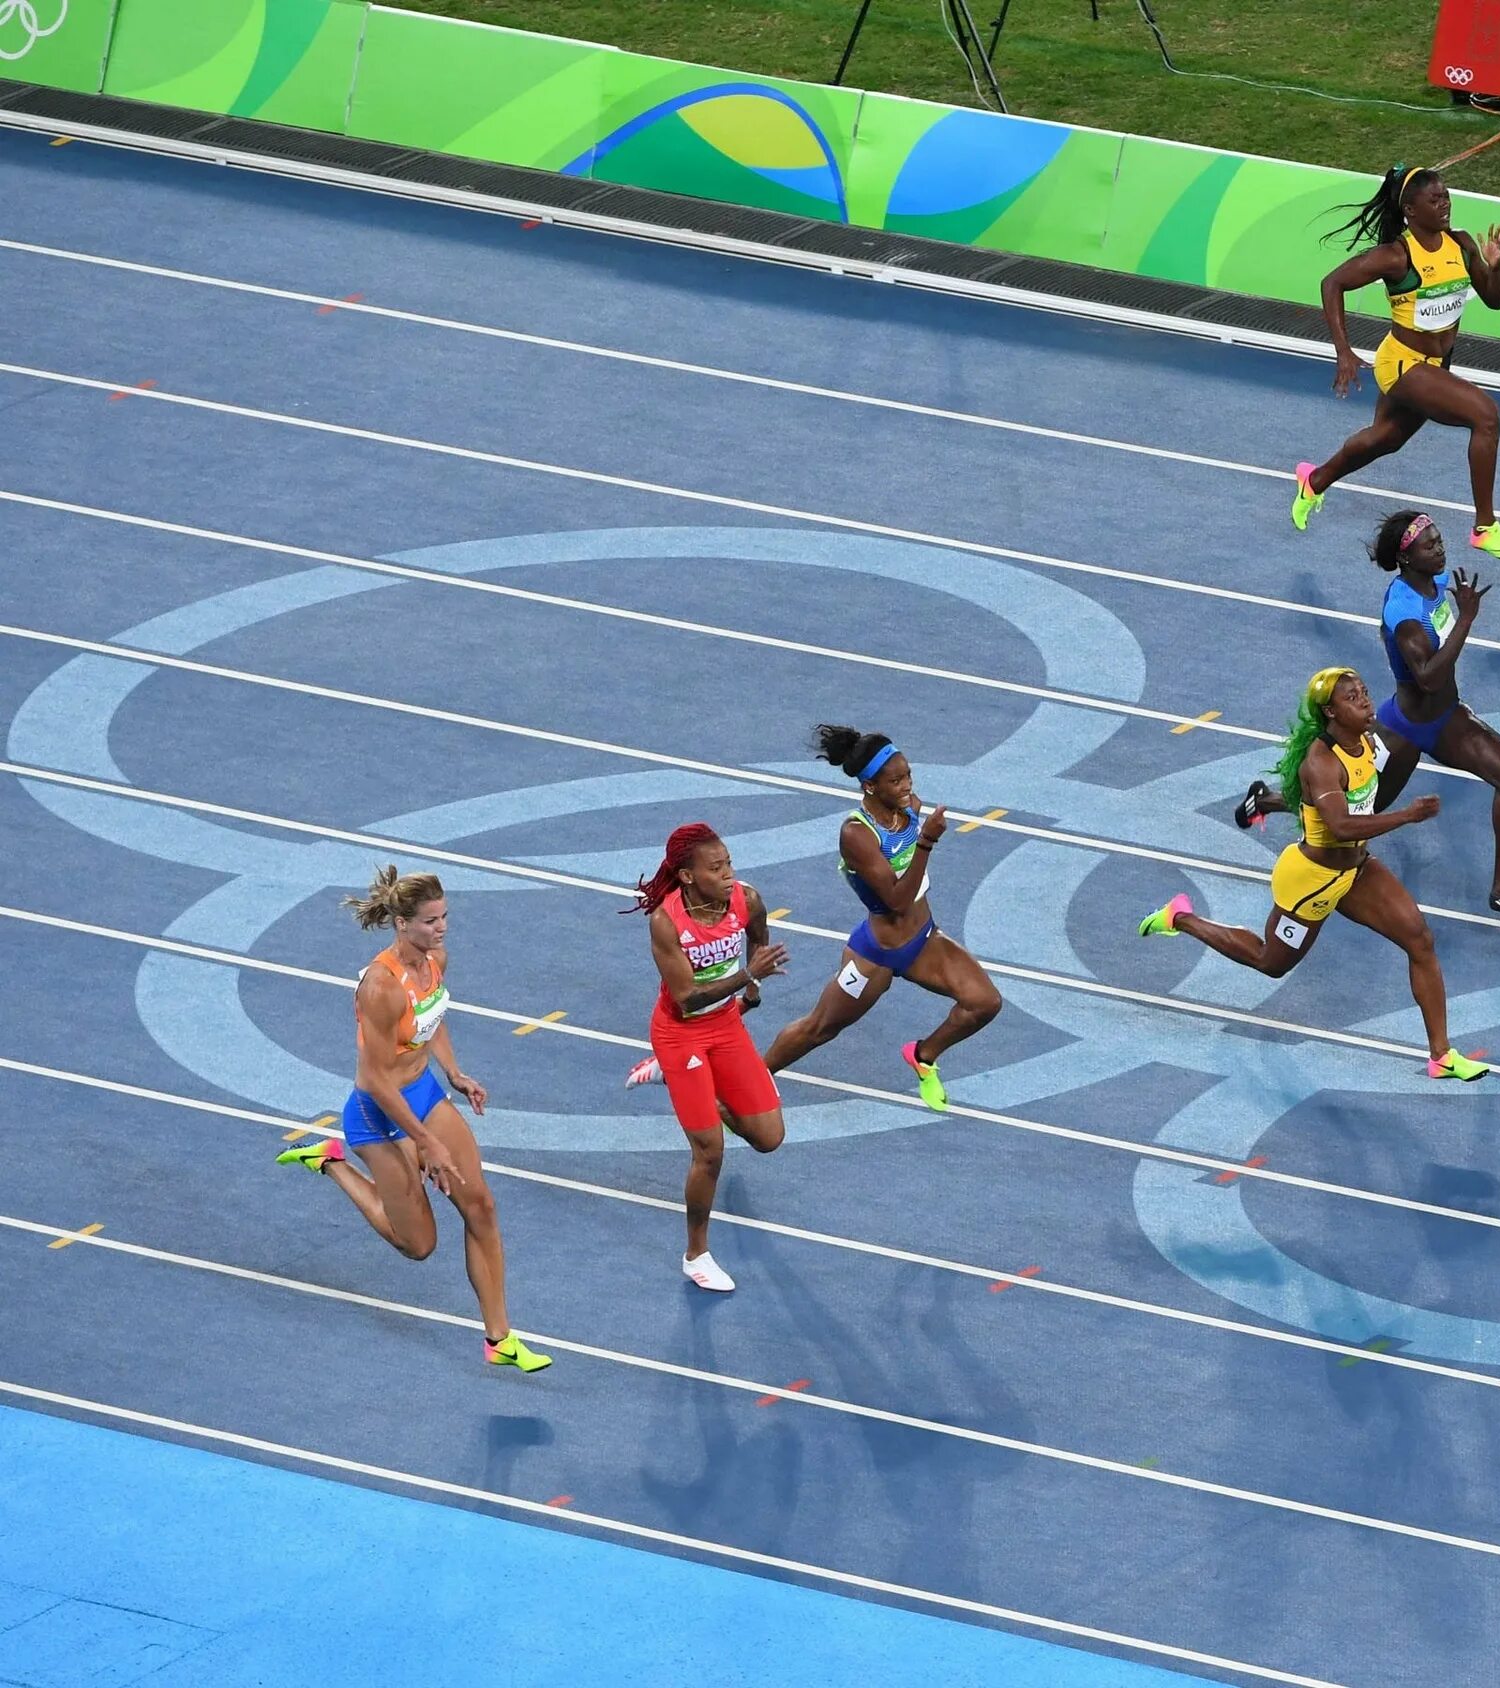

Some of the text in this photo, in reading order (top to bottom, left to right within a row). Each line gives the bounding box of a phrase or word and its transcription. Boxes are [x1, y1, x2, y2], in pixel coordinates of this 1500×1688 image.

[1420, 298, 1462, 316] WILLIAMS
[1283, 925, 1295, 939] 6
[681, 927, 746, 960] RINIDA
[691, 941, 743, 969] TOBAG
[845, 972, 858, 986] 7
